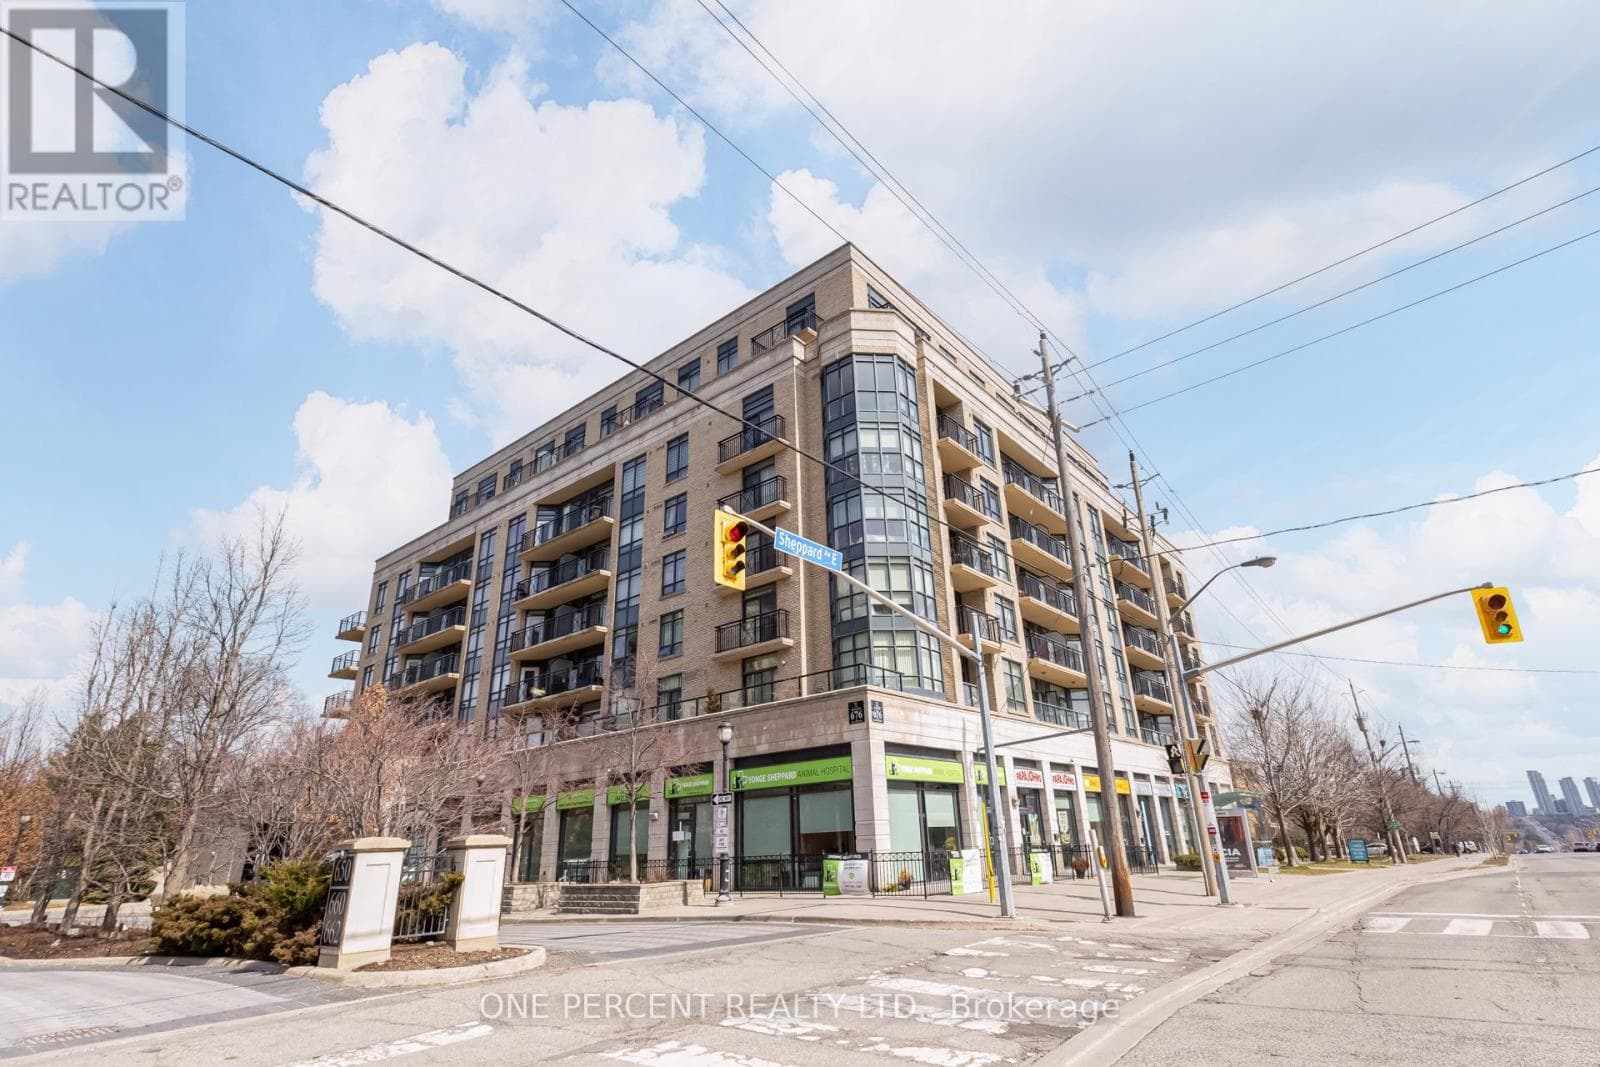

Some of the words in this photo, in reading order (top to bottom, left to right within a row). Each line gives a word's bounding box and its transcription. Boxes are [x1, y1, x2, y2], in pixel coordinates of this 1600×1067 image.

[778, 531, 823, 560] Sheppard
[831, 552, 838, 566] E
[850, 710, 863, 720] 676
[748, 774, 766, 784] YONGE
[767, 770, 797, 782] SHEPPARD
[798, 768, 819, 777] ANIMAL
[820, 765, 850, 776] HOSPITAL
[334, 859, 352, 882] 650
[329, 892, 346, 914] 660
[323, 920, 341, 943] 662
